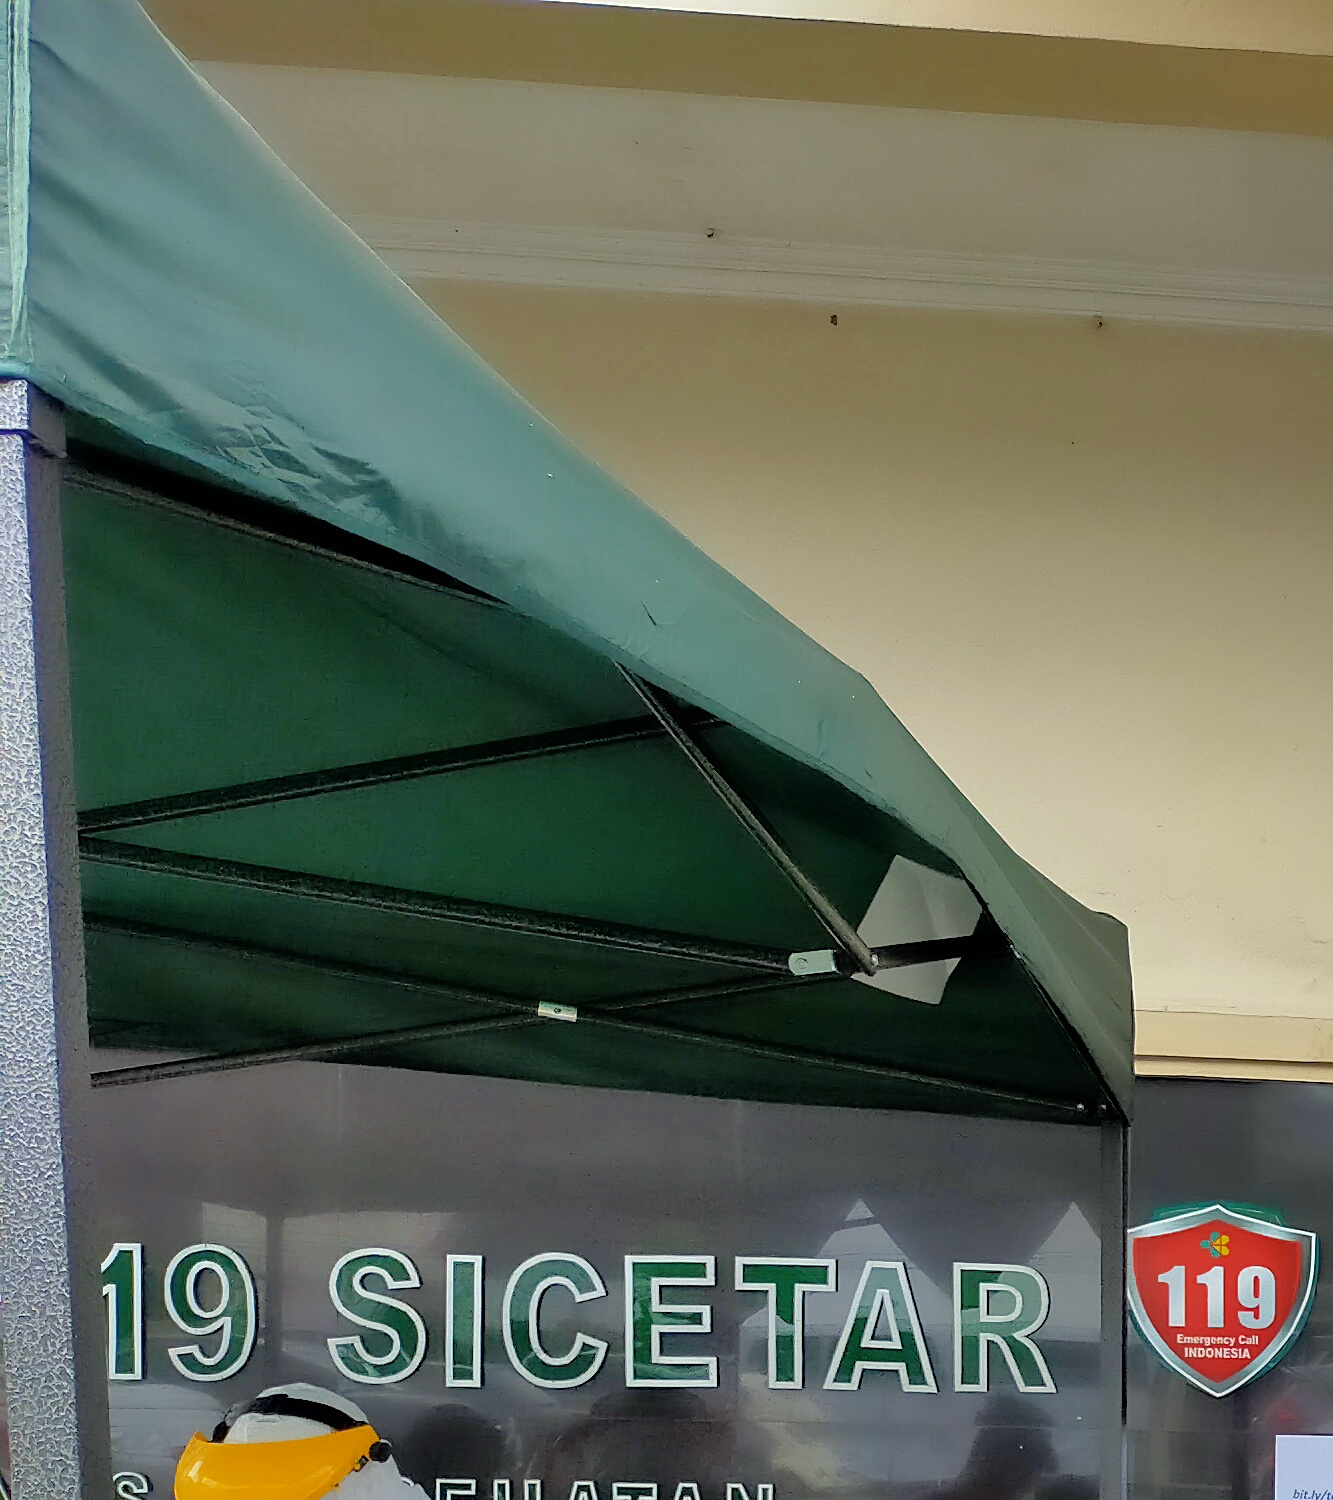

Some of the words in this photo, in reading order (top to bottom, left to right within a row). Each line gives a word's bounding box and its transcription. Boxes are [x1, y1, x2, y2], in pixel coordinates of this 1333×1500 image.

[1158, 1265, 1276, 1329] 119
[327, 1247, 1058, 1393] SICETAR
[1176, 1333, 1236, 1347] Emergency
[1238, 1334, 1259, 1345] Call
[1184, 1347, 1251, 1359] INDONESIA
